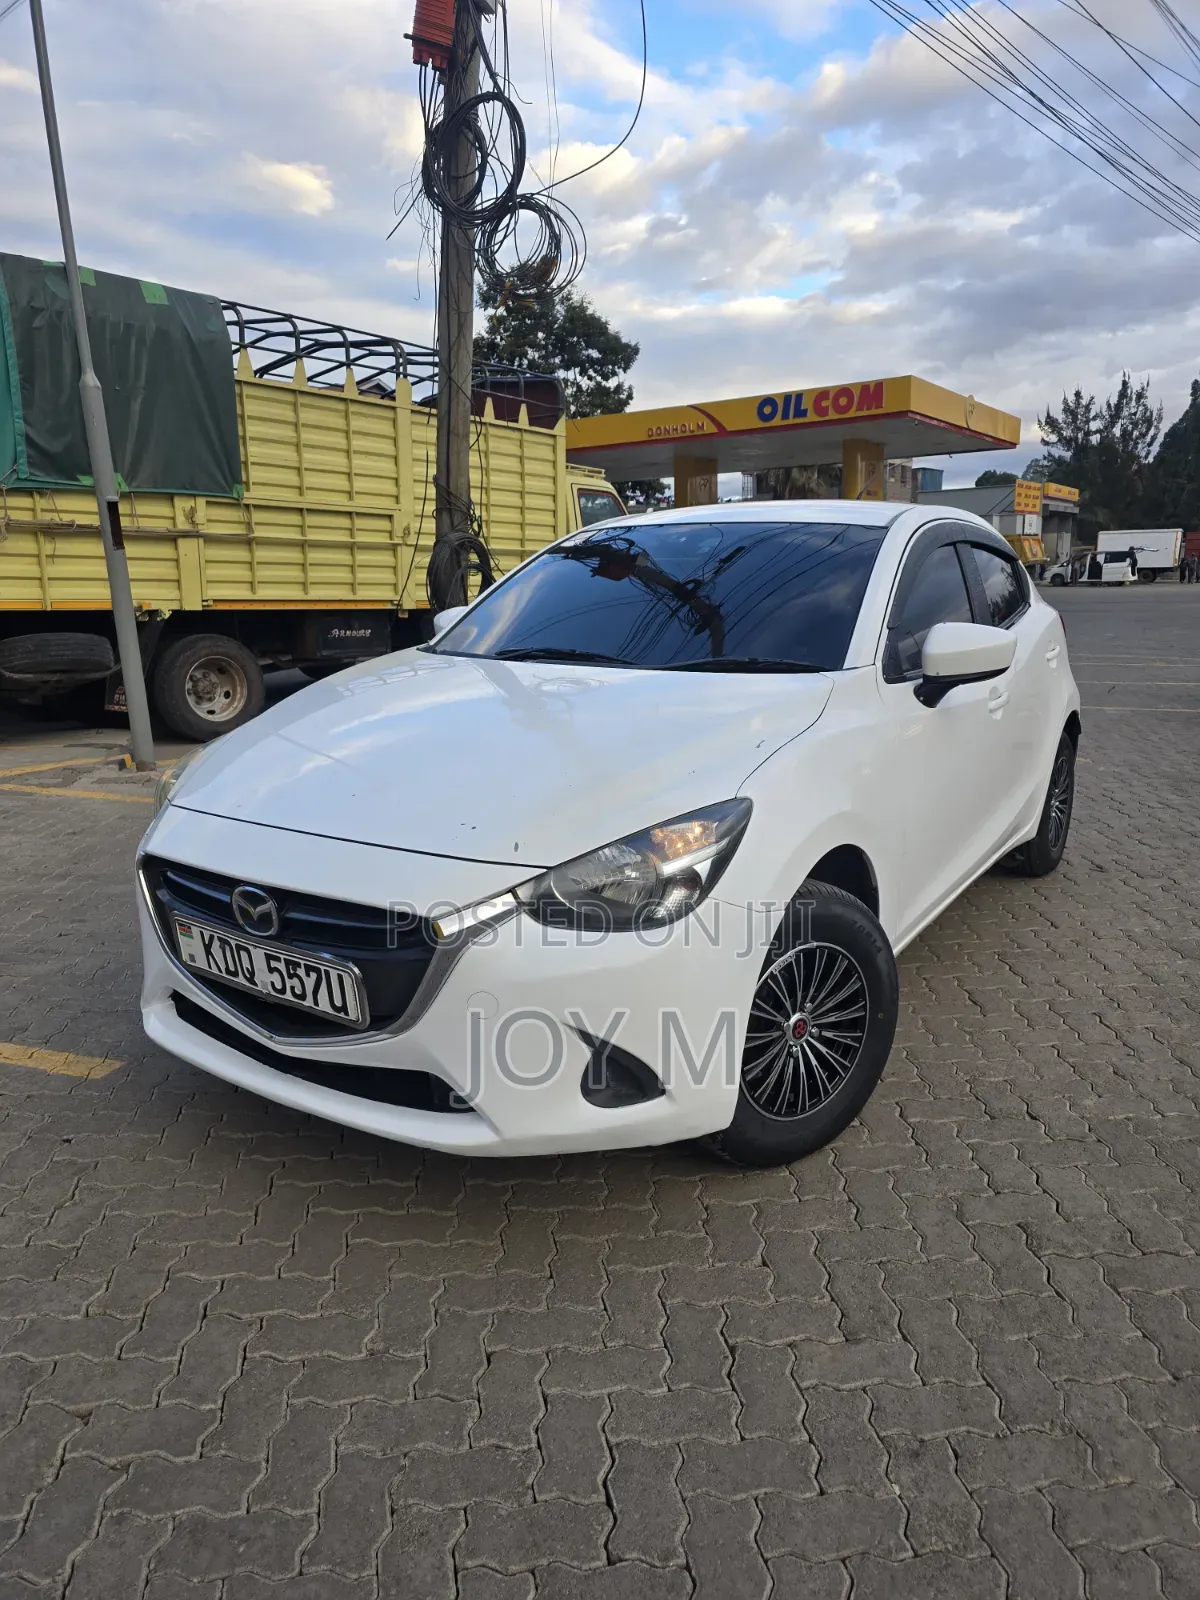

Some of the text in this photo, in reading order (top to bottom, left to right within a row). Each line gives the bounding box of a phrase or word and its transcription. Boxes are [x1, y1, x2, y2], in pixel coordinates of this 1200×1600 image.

[647, 421, 706, 438] DONHOLM
[200, 930, 350, 1017] KDQ 557U
